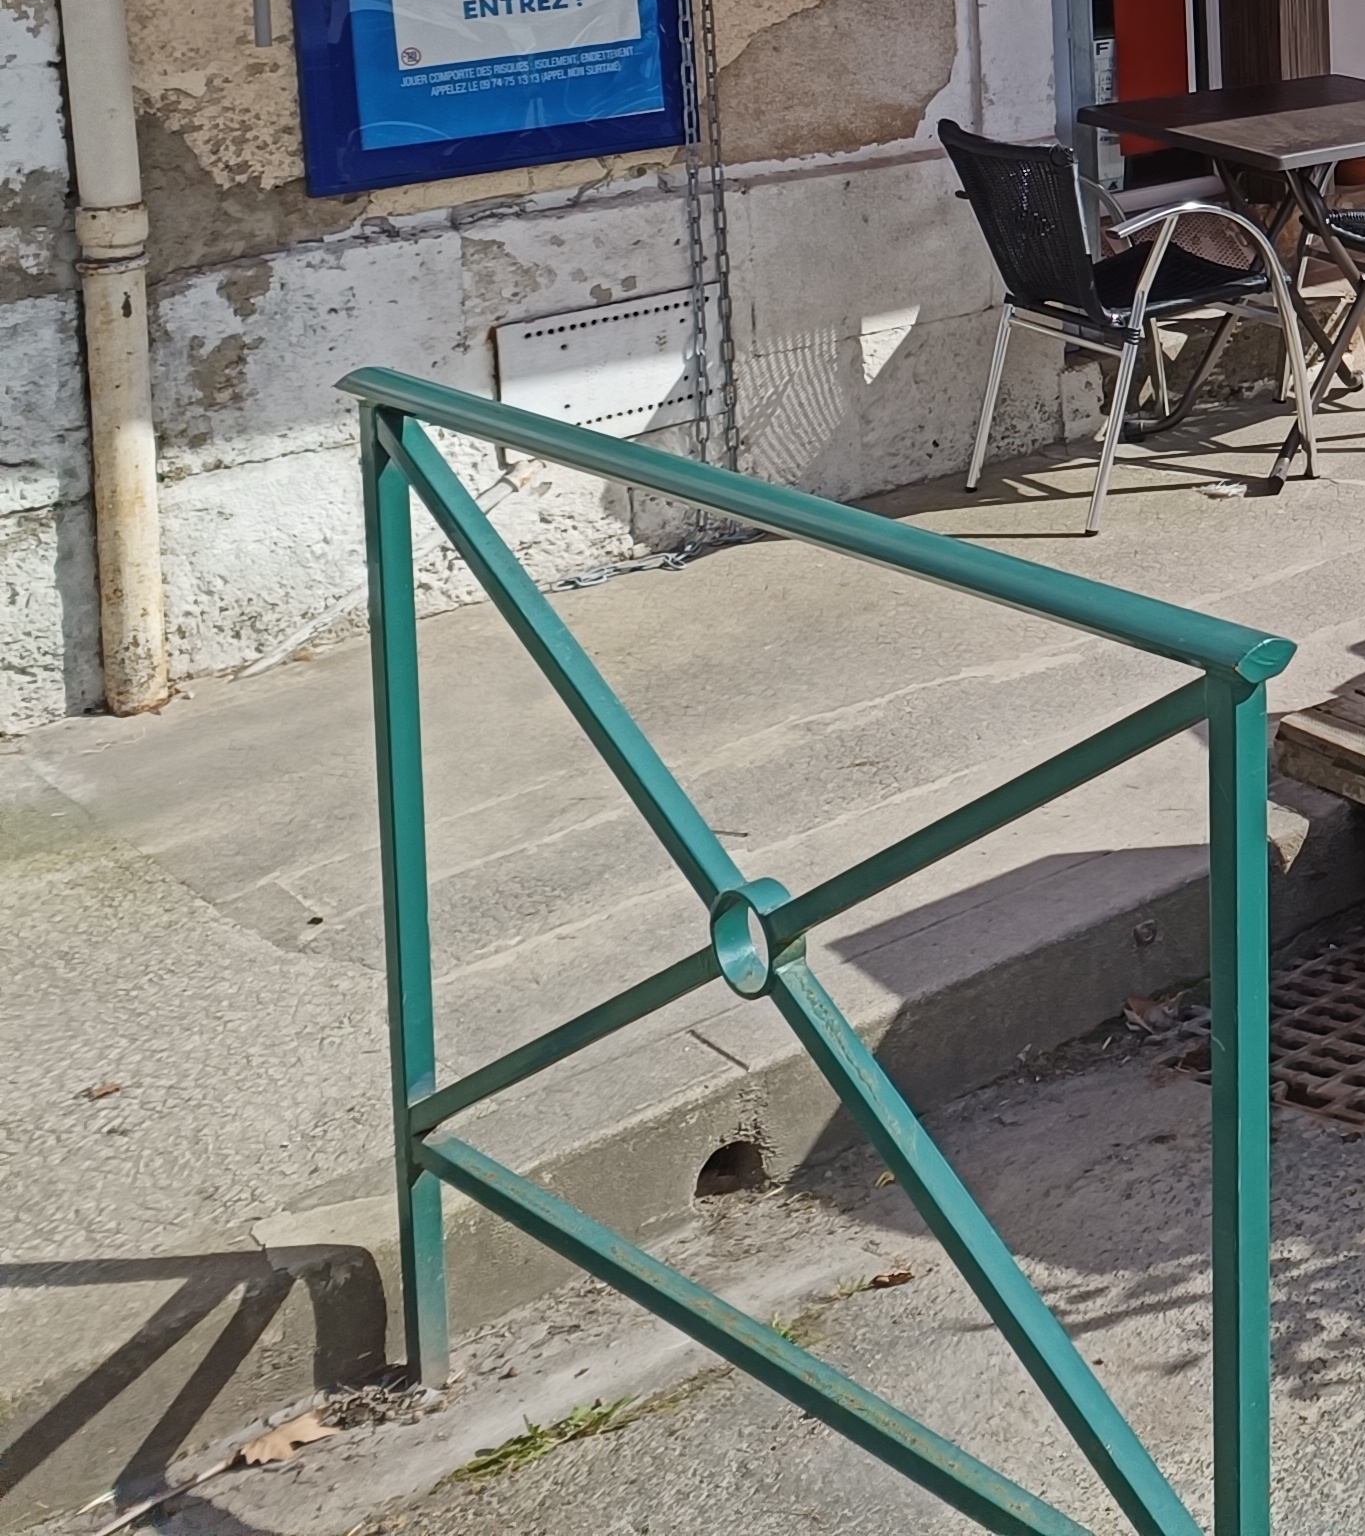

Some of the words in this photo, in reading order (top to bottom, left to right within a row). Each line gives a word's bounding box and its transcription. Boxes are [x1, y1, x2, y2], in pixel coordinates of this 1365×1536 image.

[400, 74, 427, 88] JOUER
[429, 68, 475, 83] COMPORTE
[476, 66, 493, 77] DES
[430, 82, 467, 97] APPELEZ
[468, 81, 478, 92] LE
[479, 79, 490, 90] 09
